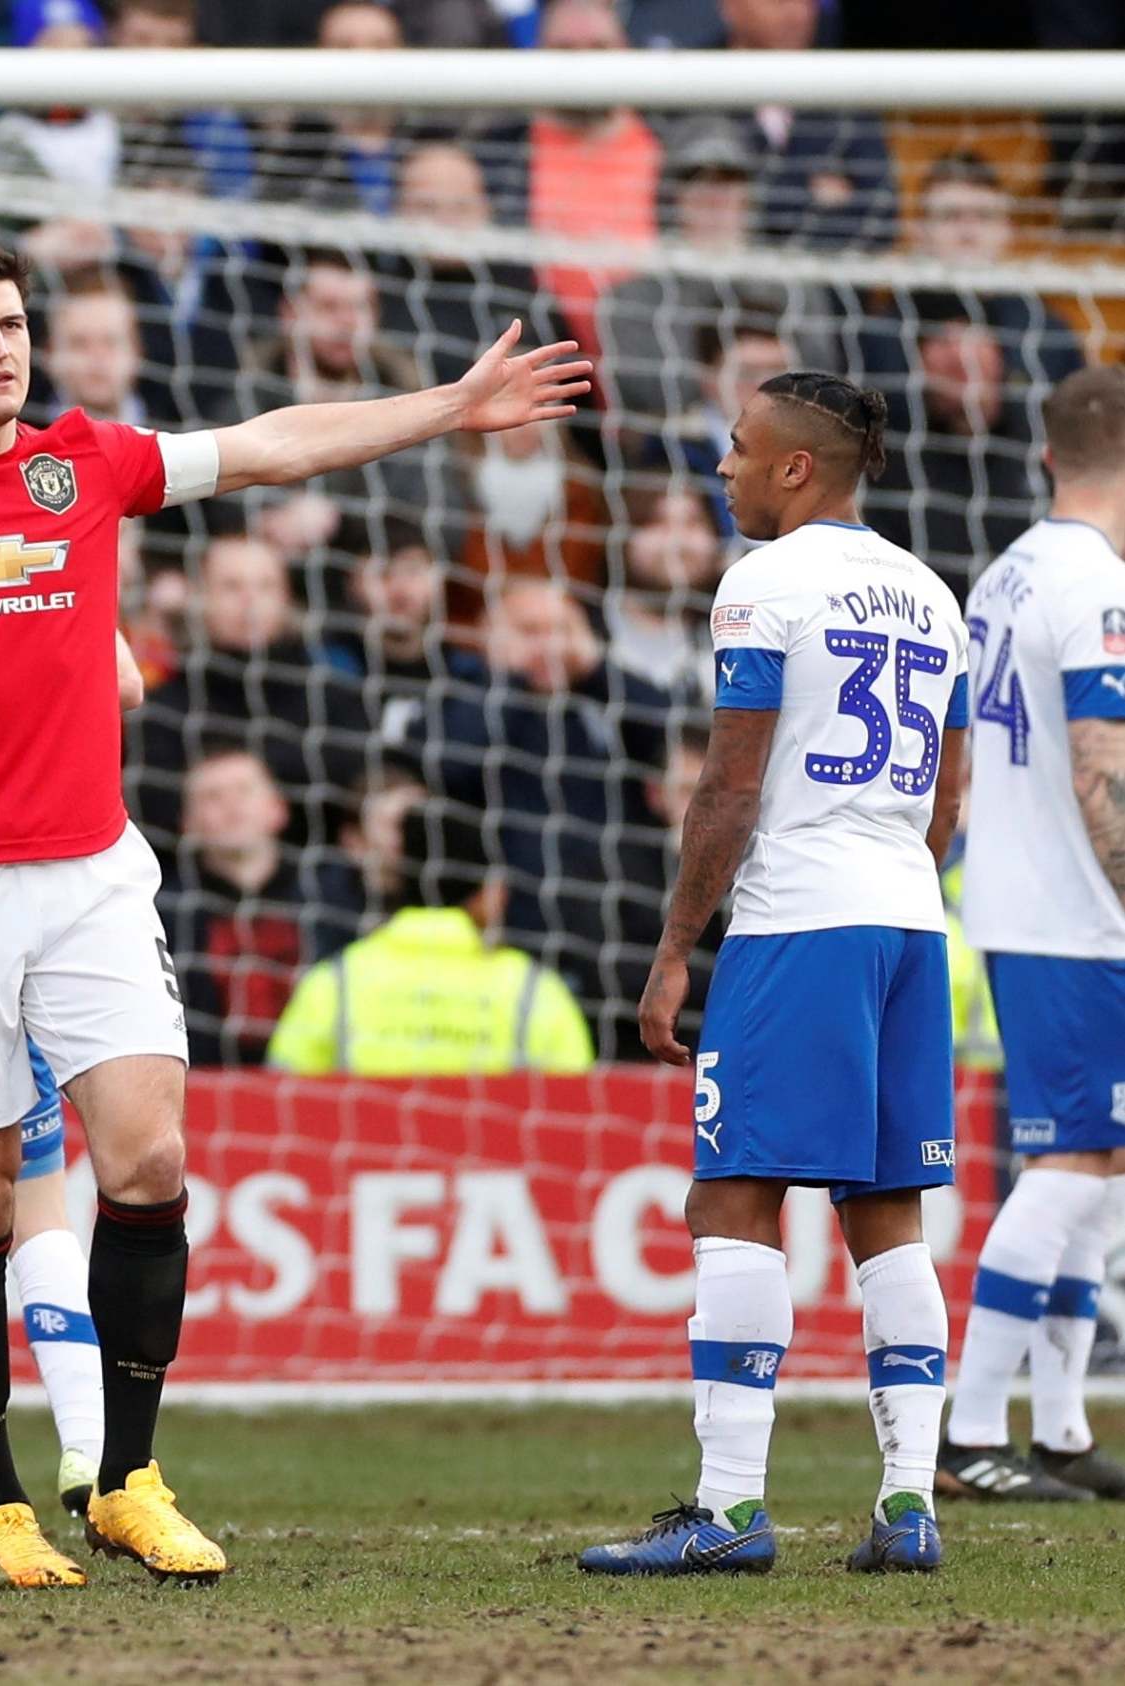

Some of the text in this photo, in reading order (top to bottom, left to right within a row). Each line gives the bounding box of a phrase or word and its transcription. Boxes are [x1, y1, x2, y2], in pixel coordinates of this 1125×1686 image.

[843, 584, 935, 635] DANNS
[805, 629, 949, 797] 35
[694, 1051, 721, 1123] 5
[350, 1169, 569, 1317] FA
